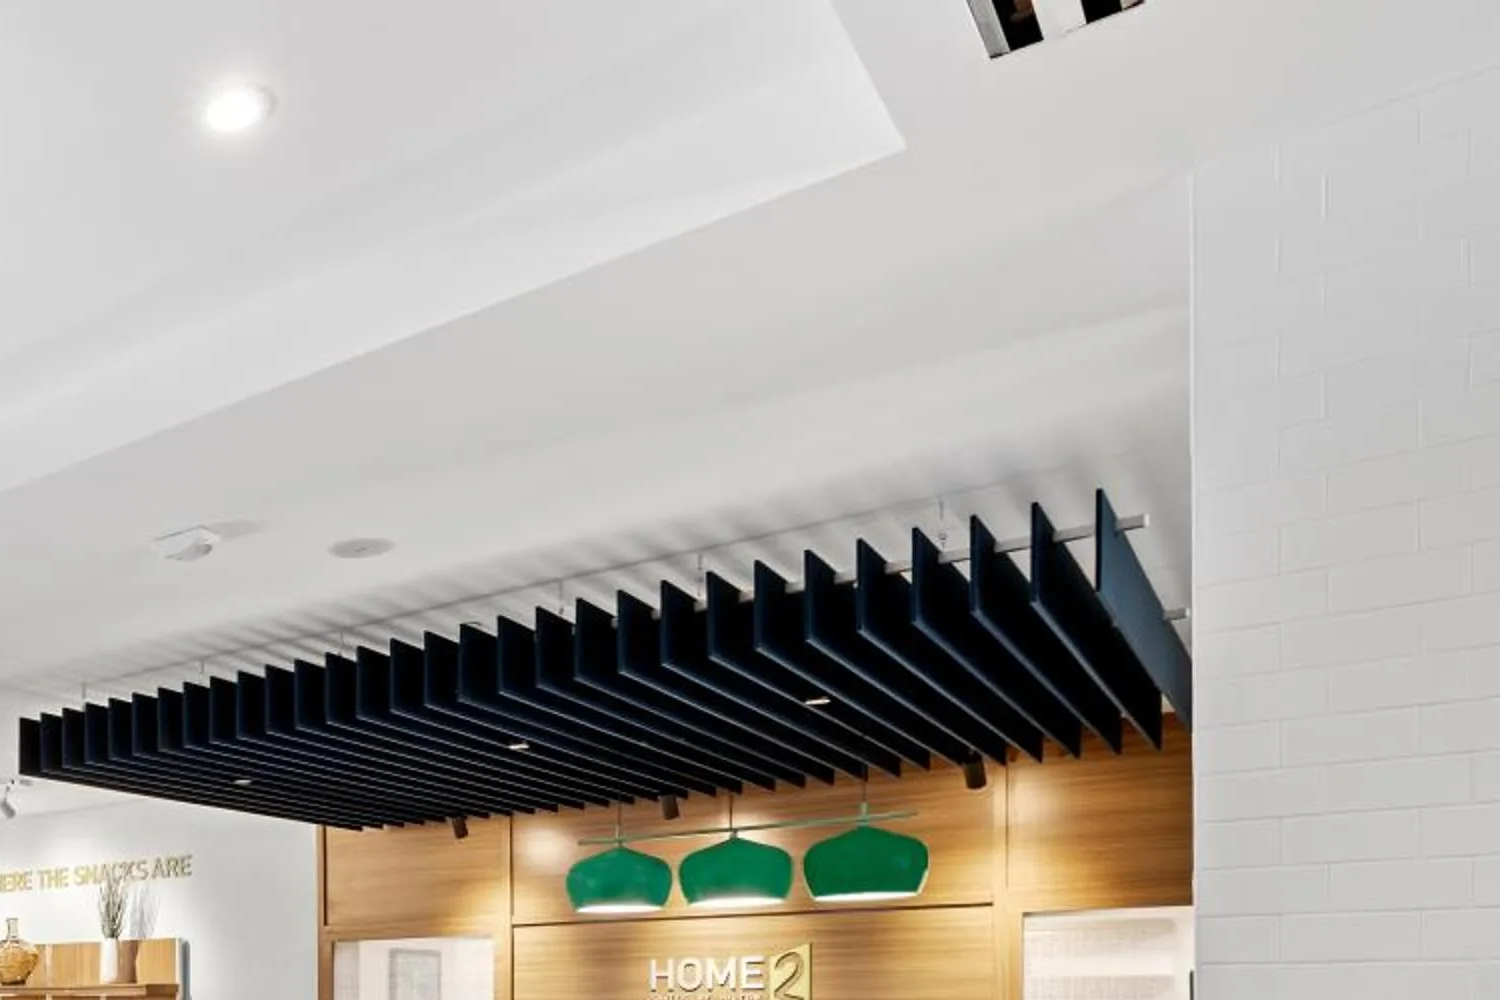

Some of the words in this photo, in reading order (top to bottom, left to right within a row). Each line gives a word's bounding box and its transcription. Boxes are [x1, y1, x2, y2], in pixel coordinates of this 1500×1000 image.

[37, 866, 69, 891] THE
[74, 859, 149, 887] SNACKS
[152, 853, 193, 880] ARE
